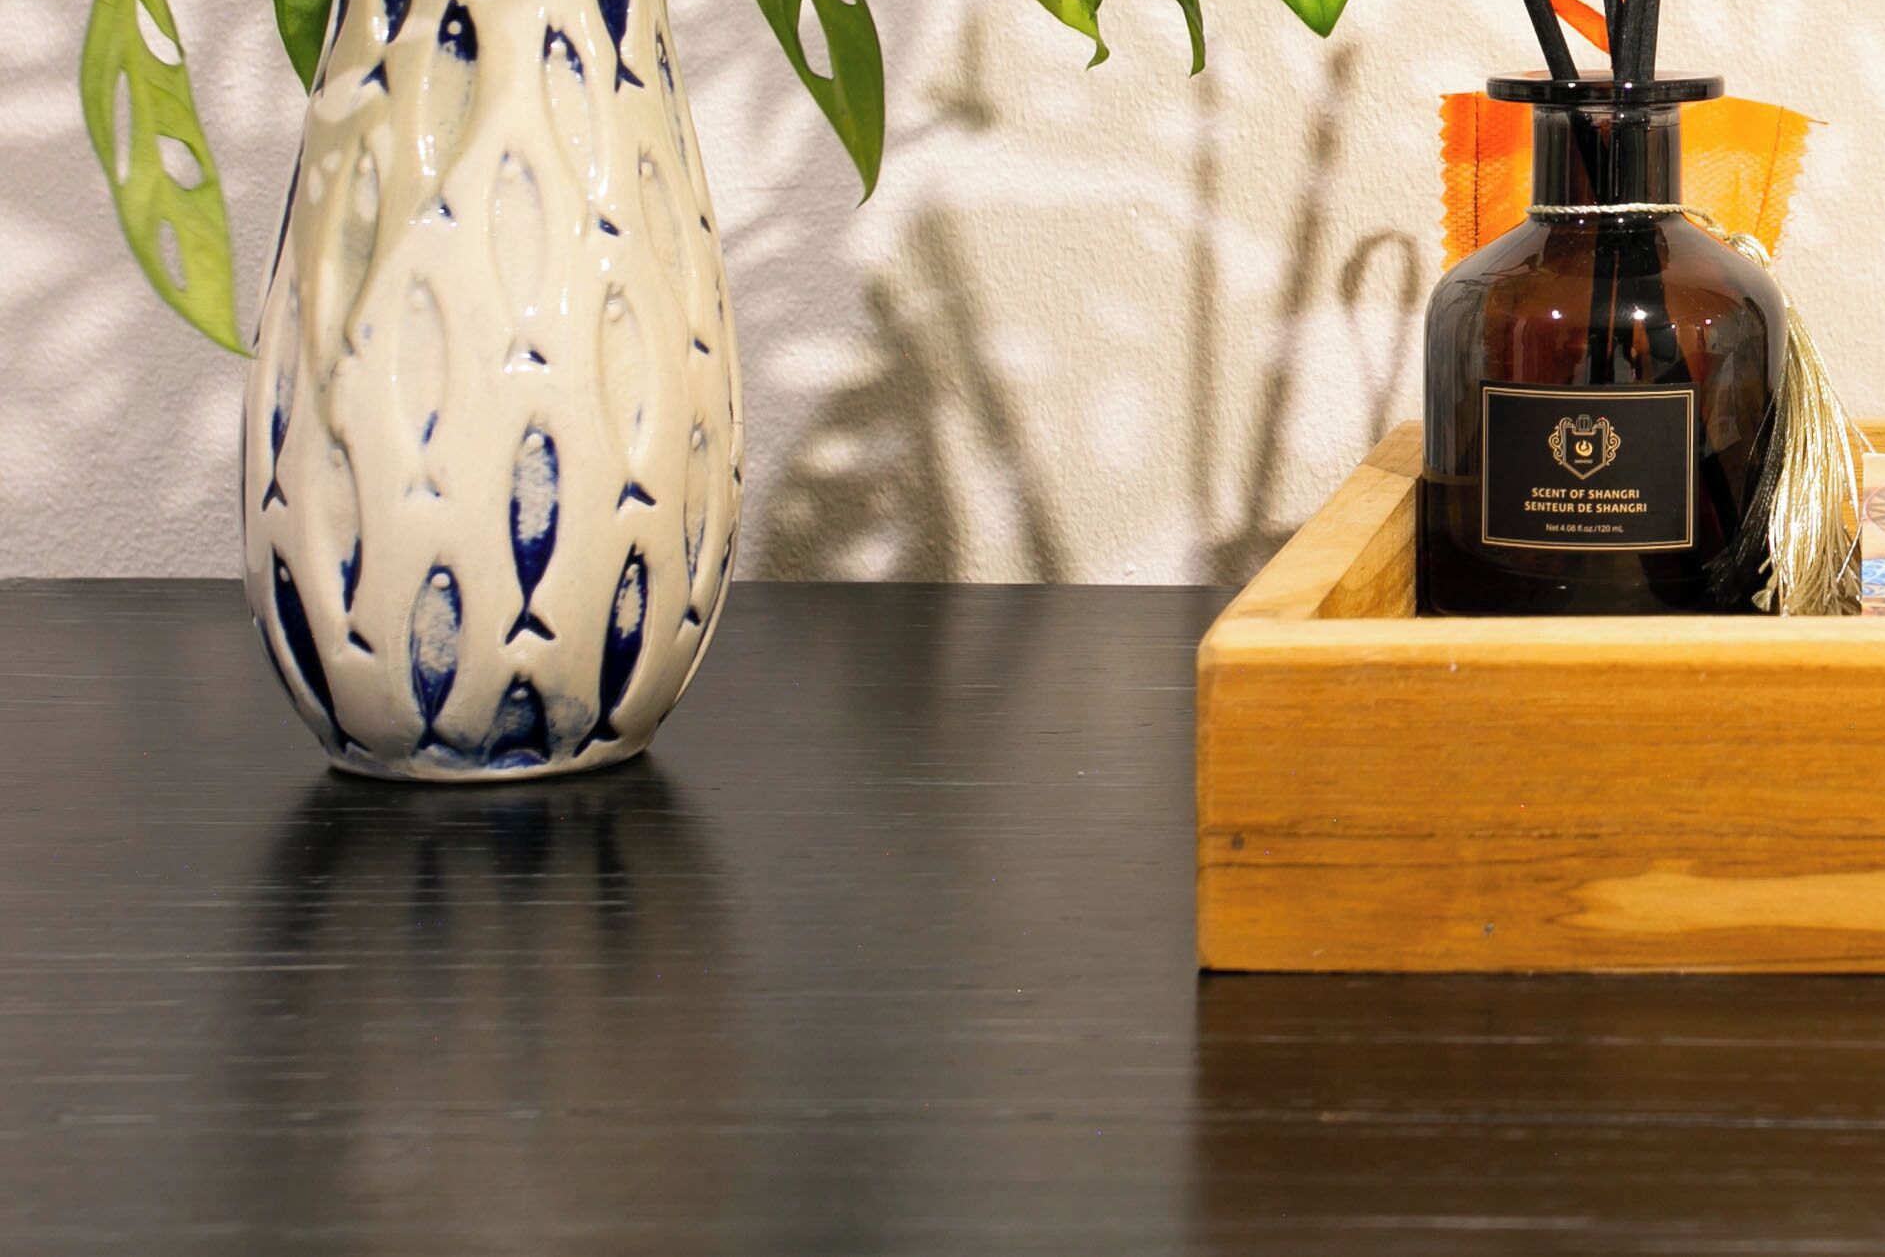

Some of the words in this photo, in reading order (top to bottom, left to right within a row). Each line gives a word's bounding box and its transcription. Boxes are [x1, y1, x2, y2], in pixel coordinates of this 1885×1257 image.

[1531, 487, 1567, 499] SCENT
[1569, 489, 1586, 499] OF
[1588, 489, 1640, 499] SHANGRI
[1524, 501, 1575, 513] SENTEUR
[1577, 503, 1593, 513] DE
[1595, 503, 1648, 513] SHANGRI
[1545, 523, 1560, 532] Net
